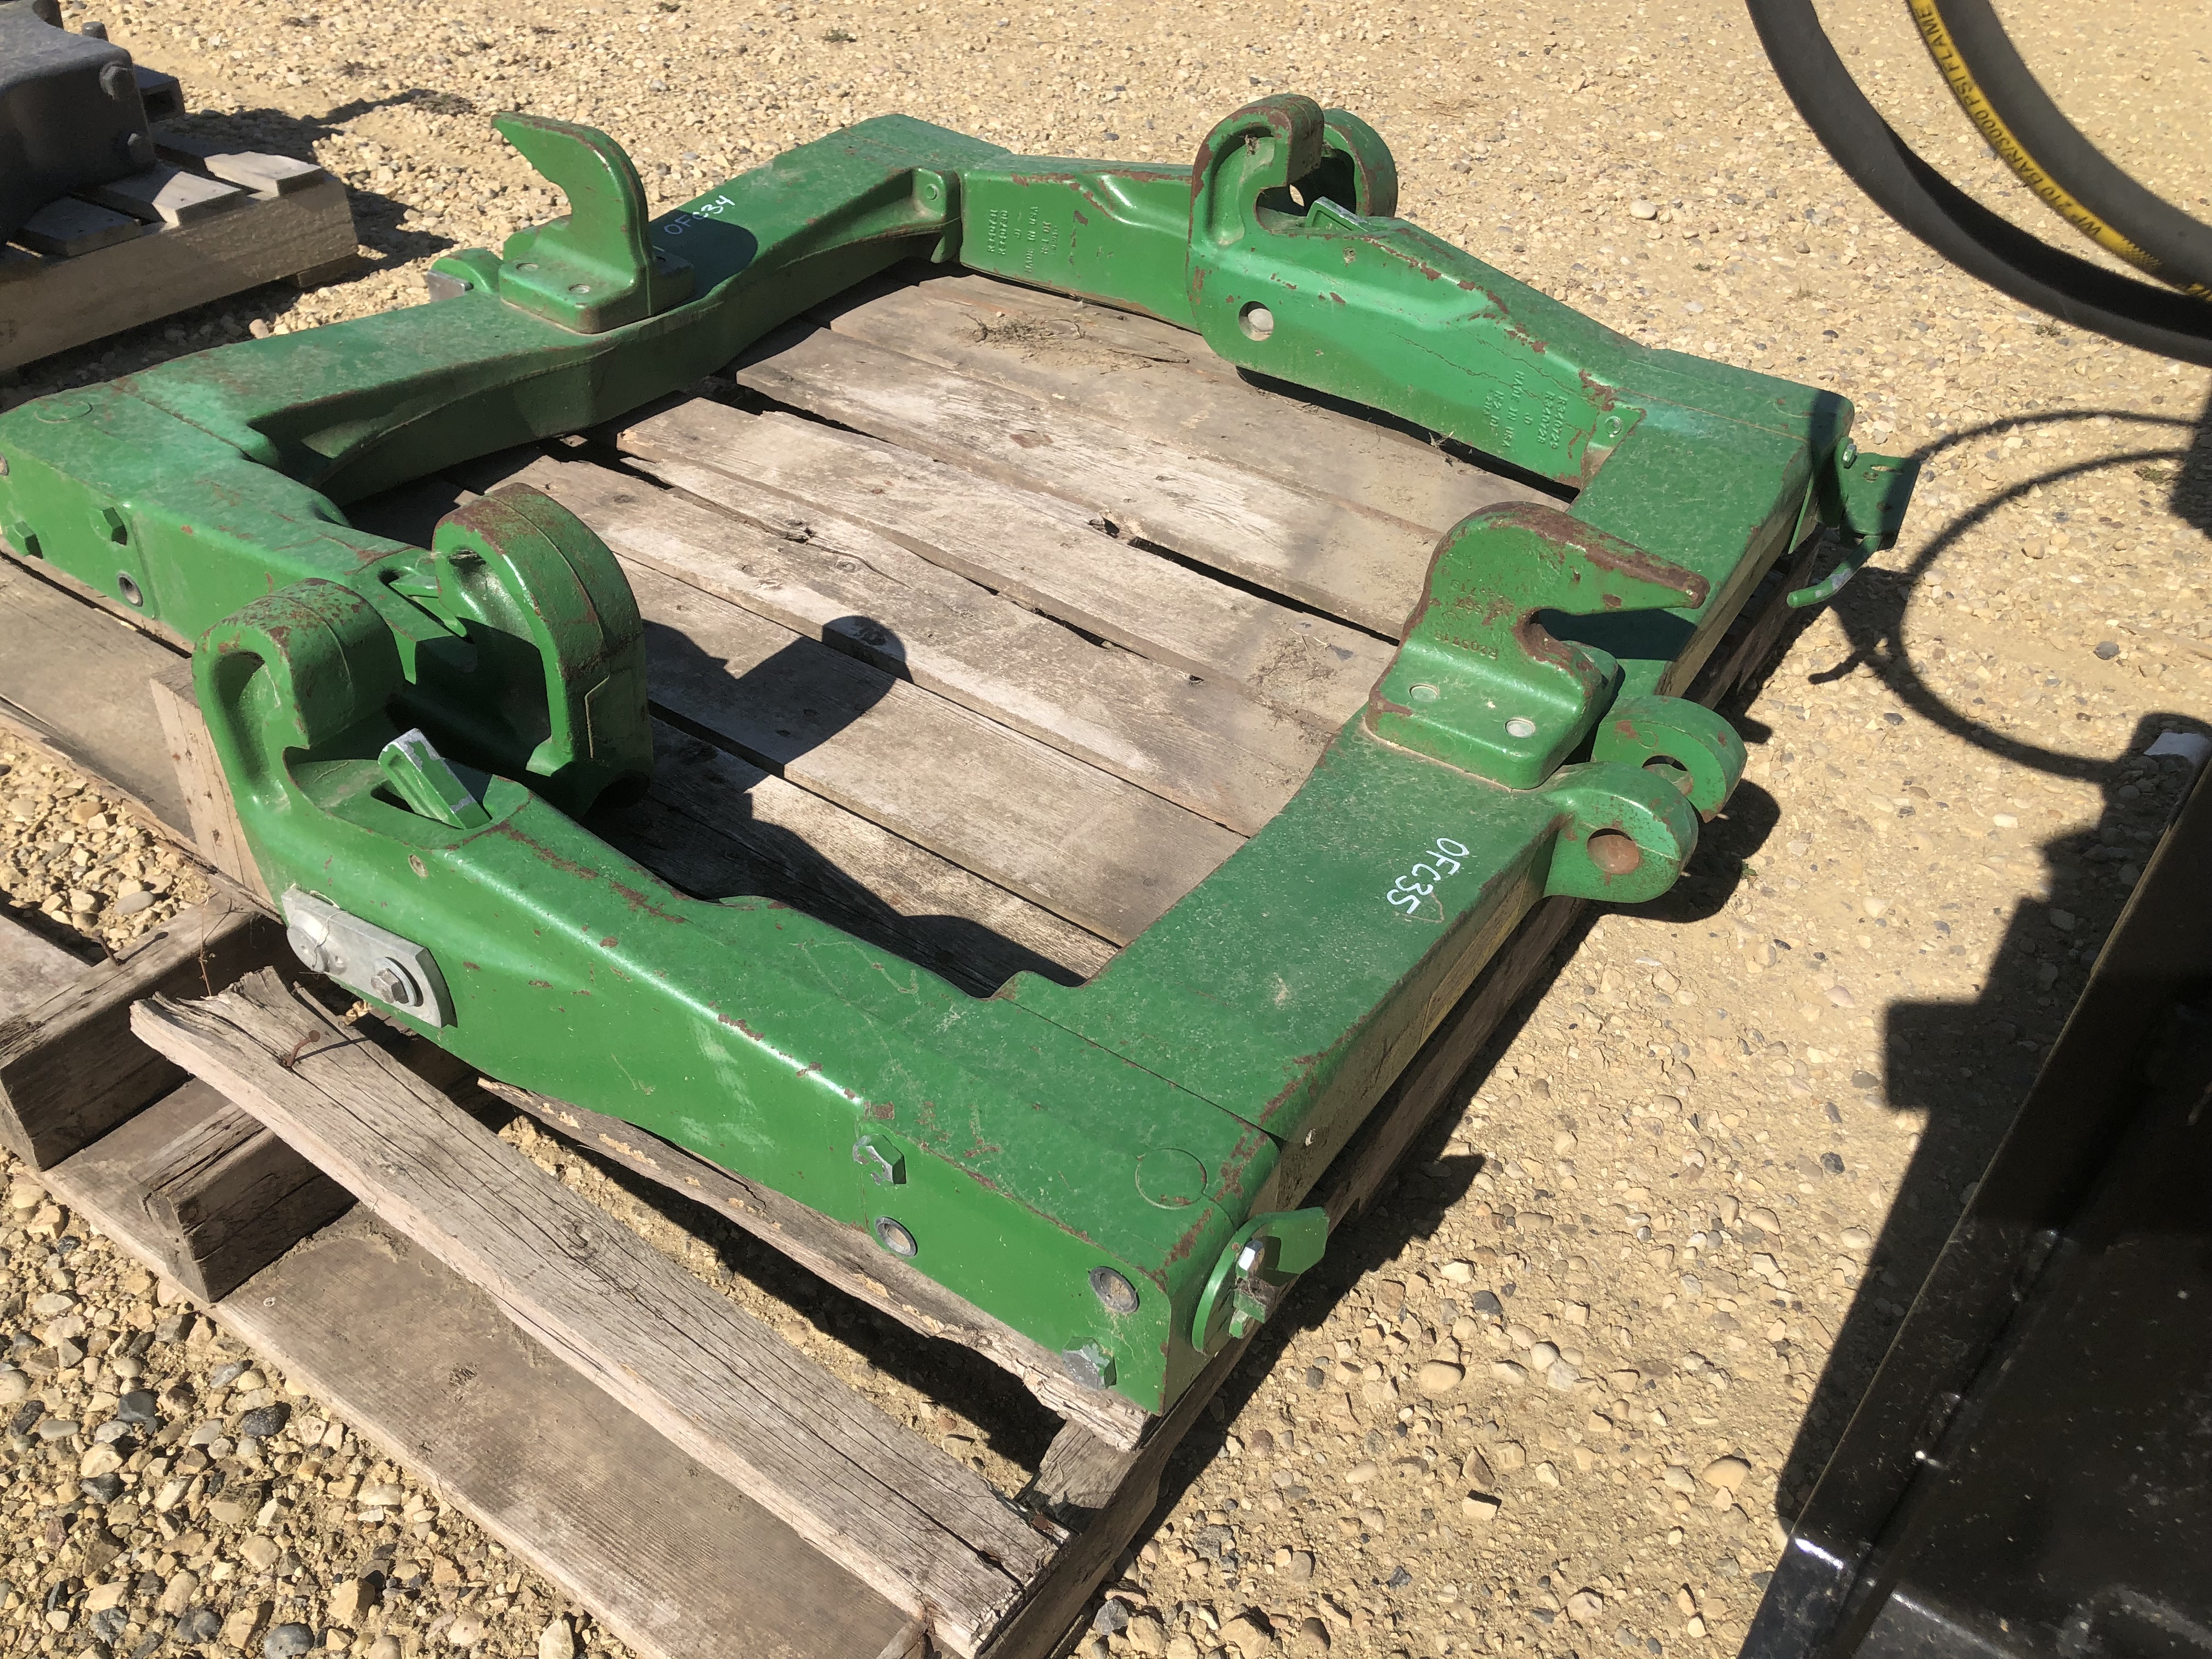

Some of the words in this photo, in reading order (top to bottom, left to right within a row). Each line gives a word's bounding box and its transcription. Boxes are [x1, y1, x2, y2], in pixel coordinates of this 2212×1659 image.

[1951, 75, 1980, 106] PSI
[1975, 110, 2044, 185] BAR/3000
[663, 195, 736, 235] OFC34
[1029, 206, 1039, 225] USA
[1027, 230, 1036, 241] IN
[1024, 249, 1034, 272] MADE
[1511, 370, 1525, 403] MADE
[1507, 407, 1518, 421] IN
[1502, 426, 1514, 448] USA
